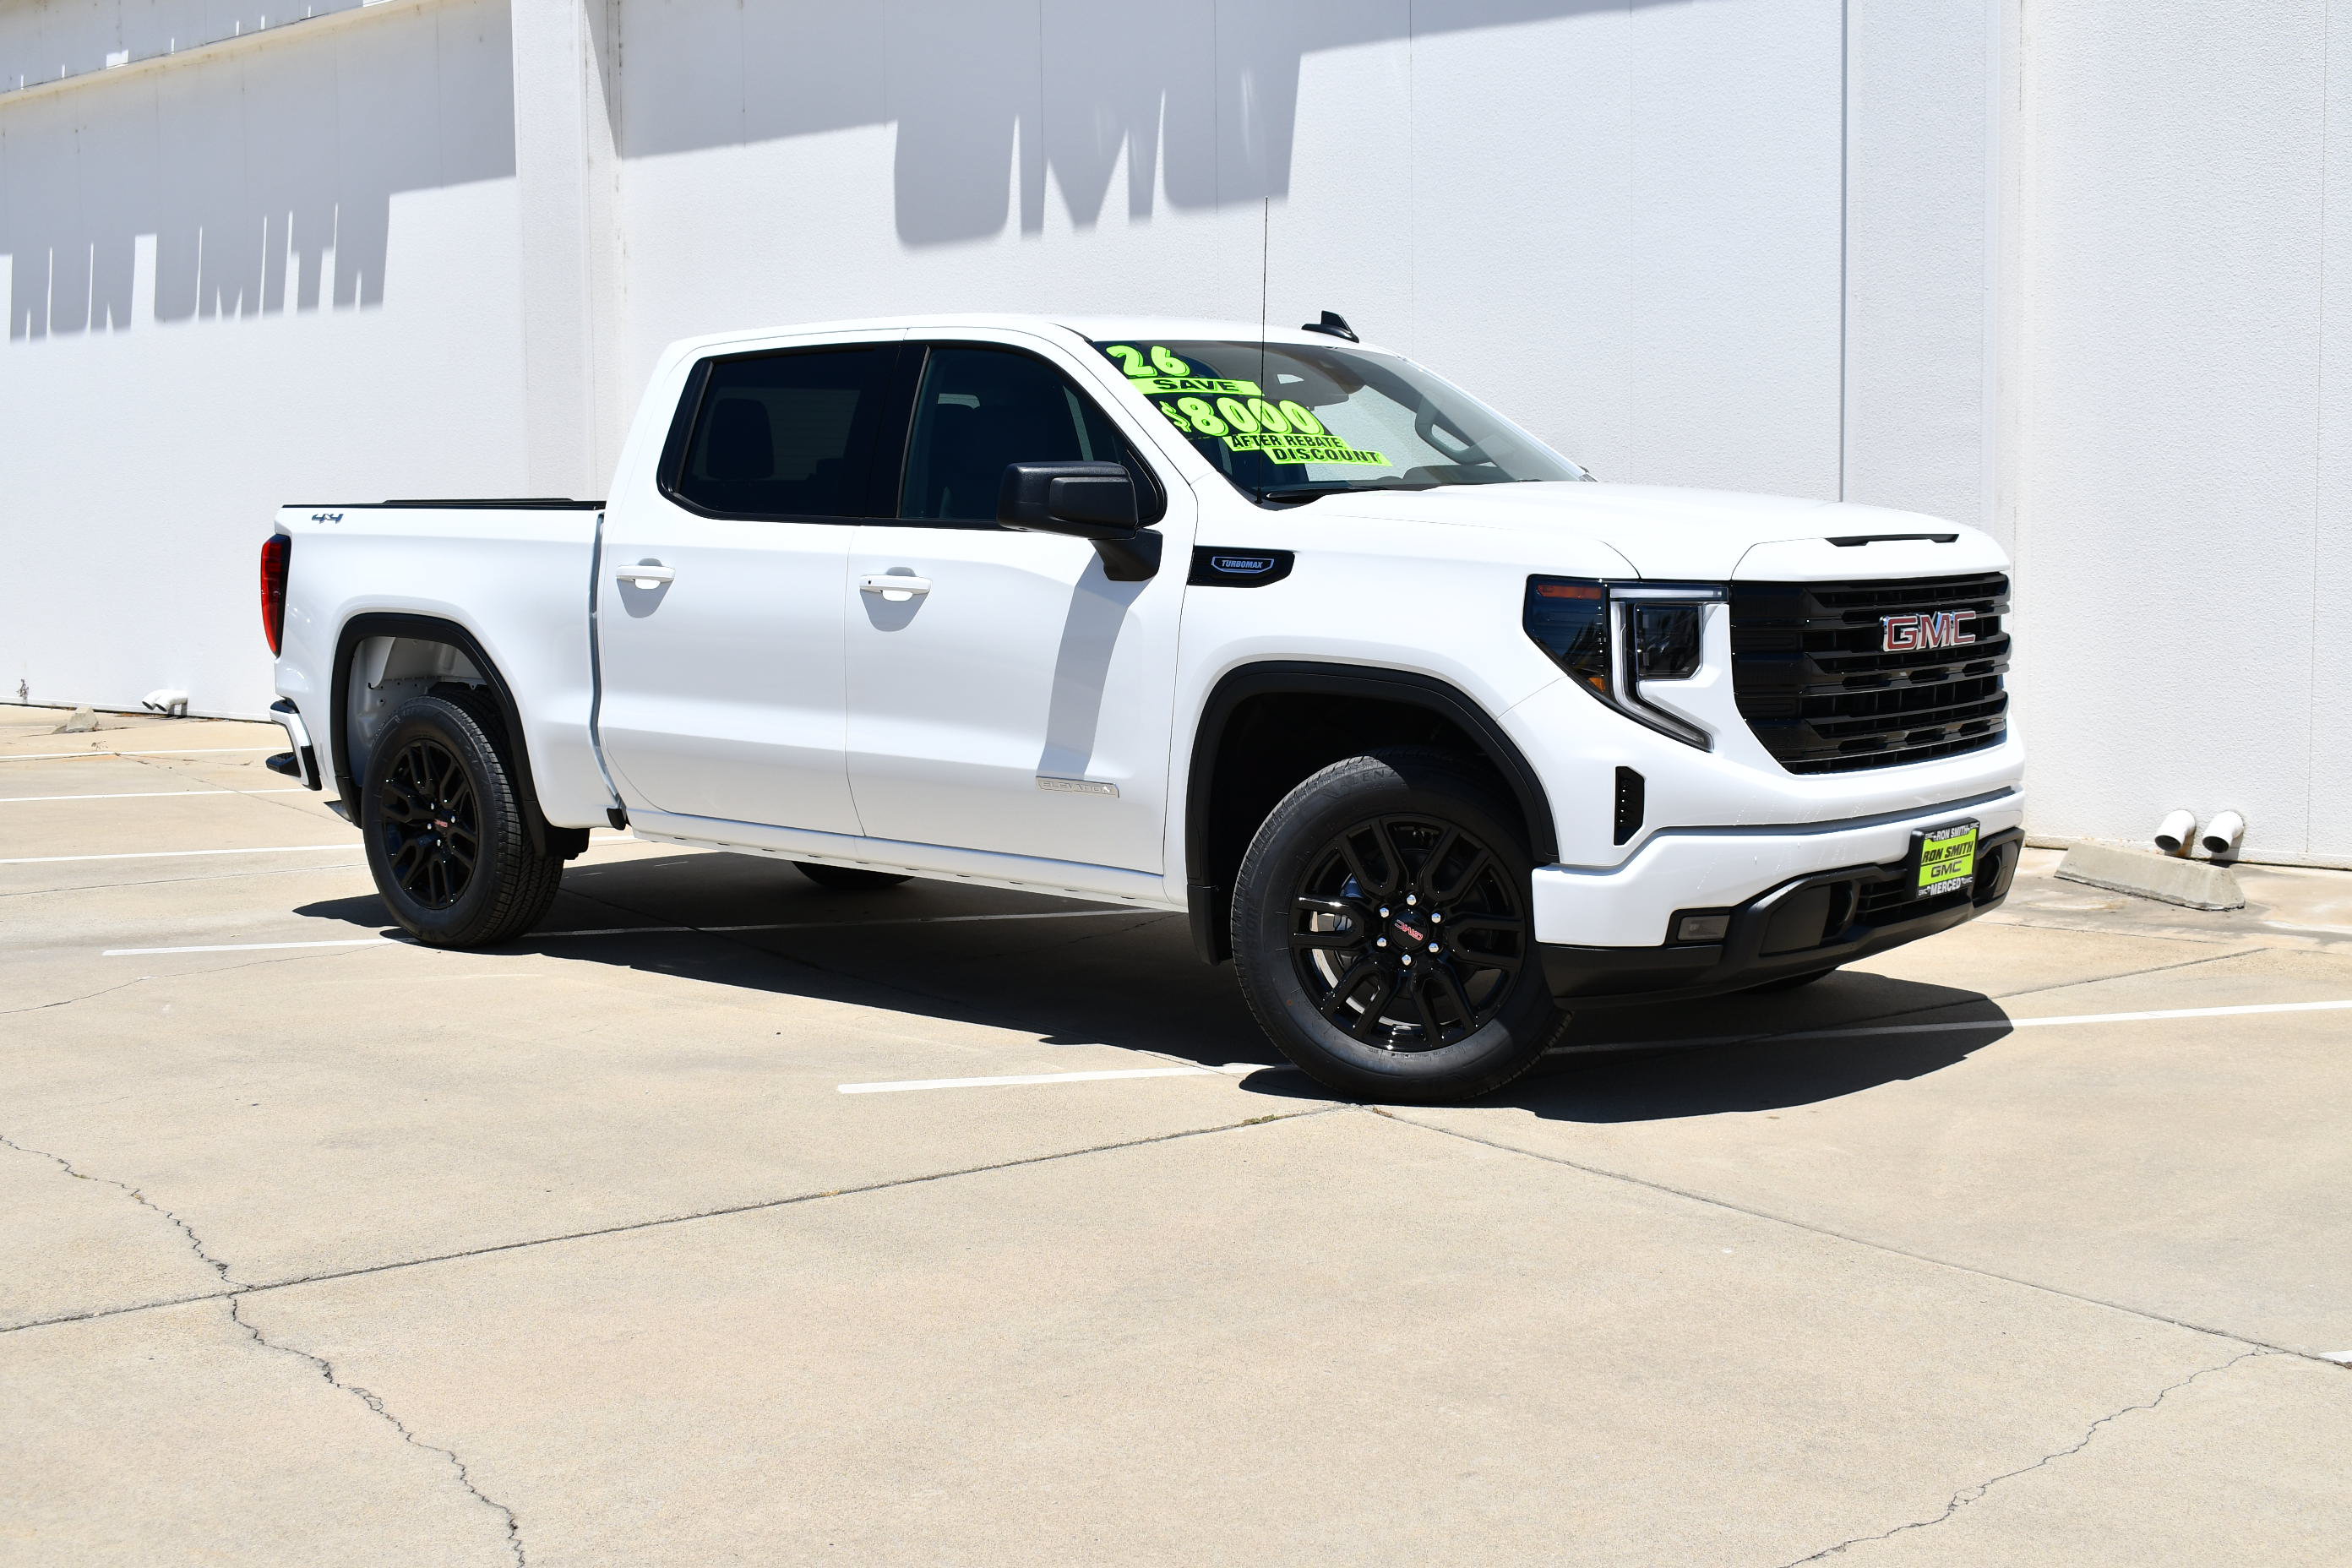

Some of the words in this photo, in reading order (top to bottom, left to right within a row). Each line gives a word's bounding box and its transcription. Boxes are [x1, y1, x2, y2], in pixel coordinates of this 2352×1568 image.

[1106, 345, 1190, 377] 26
[1153, 378, 1241, 393] SAVE
[1158, 397, 1325, 437] $8000
[1232, 435, 1282, 449] AFTER
[1283, 435, 1343, 449] REBATE
[1272, 448, 1380, 463] DISCOUNT
[1222, 559, 1263, 569] TURBOMAX
[1880, 611, 1976, 652] GMC
[1041, 780, 1111, 794] ELEVATION
[1936, 828, 1951, 841] RON
[1951, 825, 1968, 838] SMITH
[1922, 847, 1943, 863] RON
[1944, 841, 1974, 858] SMITH
[1931, 860, 1962, 878] GMC
[1930, 879, 1961, 896] MERCED
[1394, 919, 1424, 941] GMC
